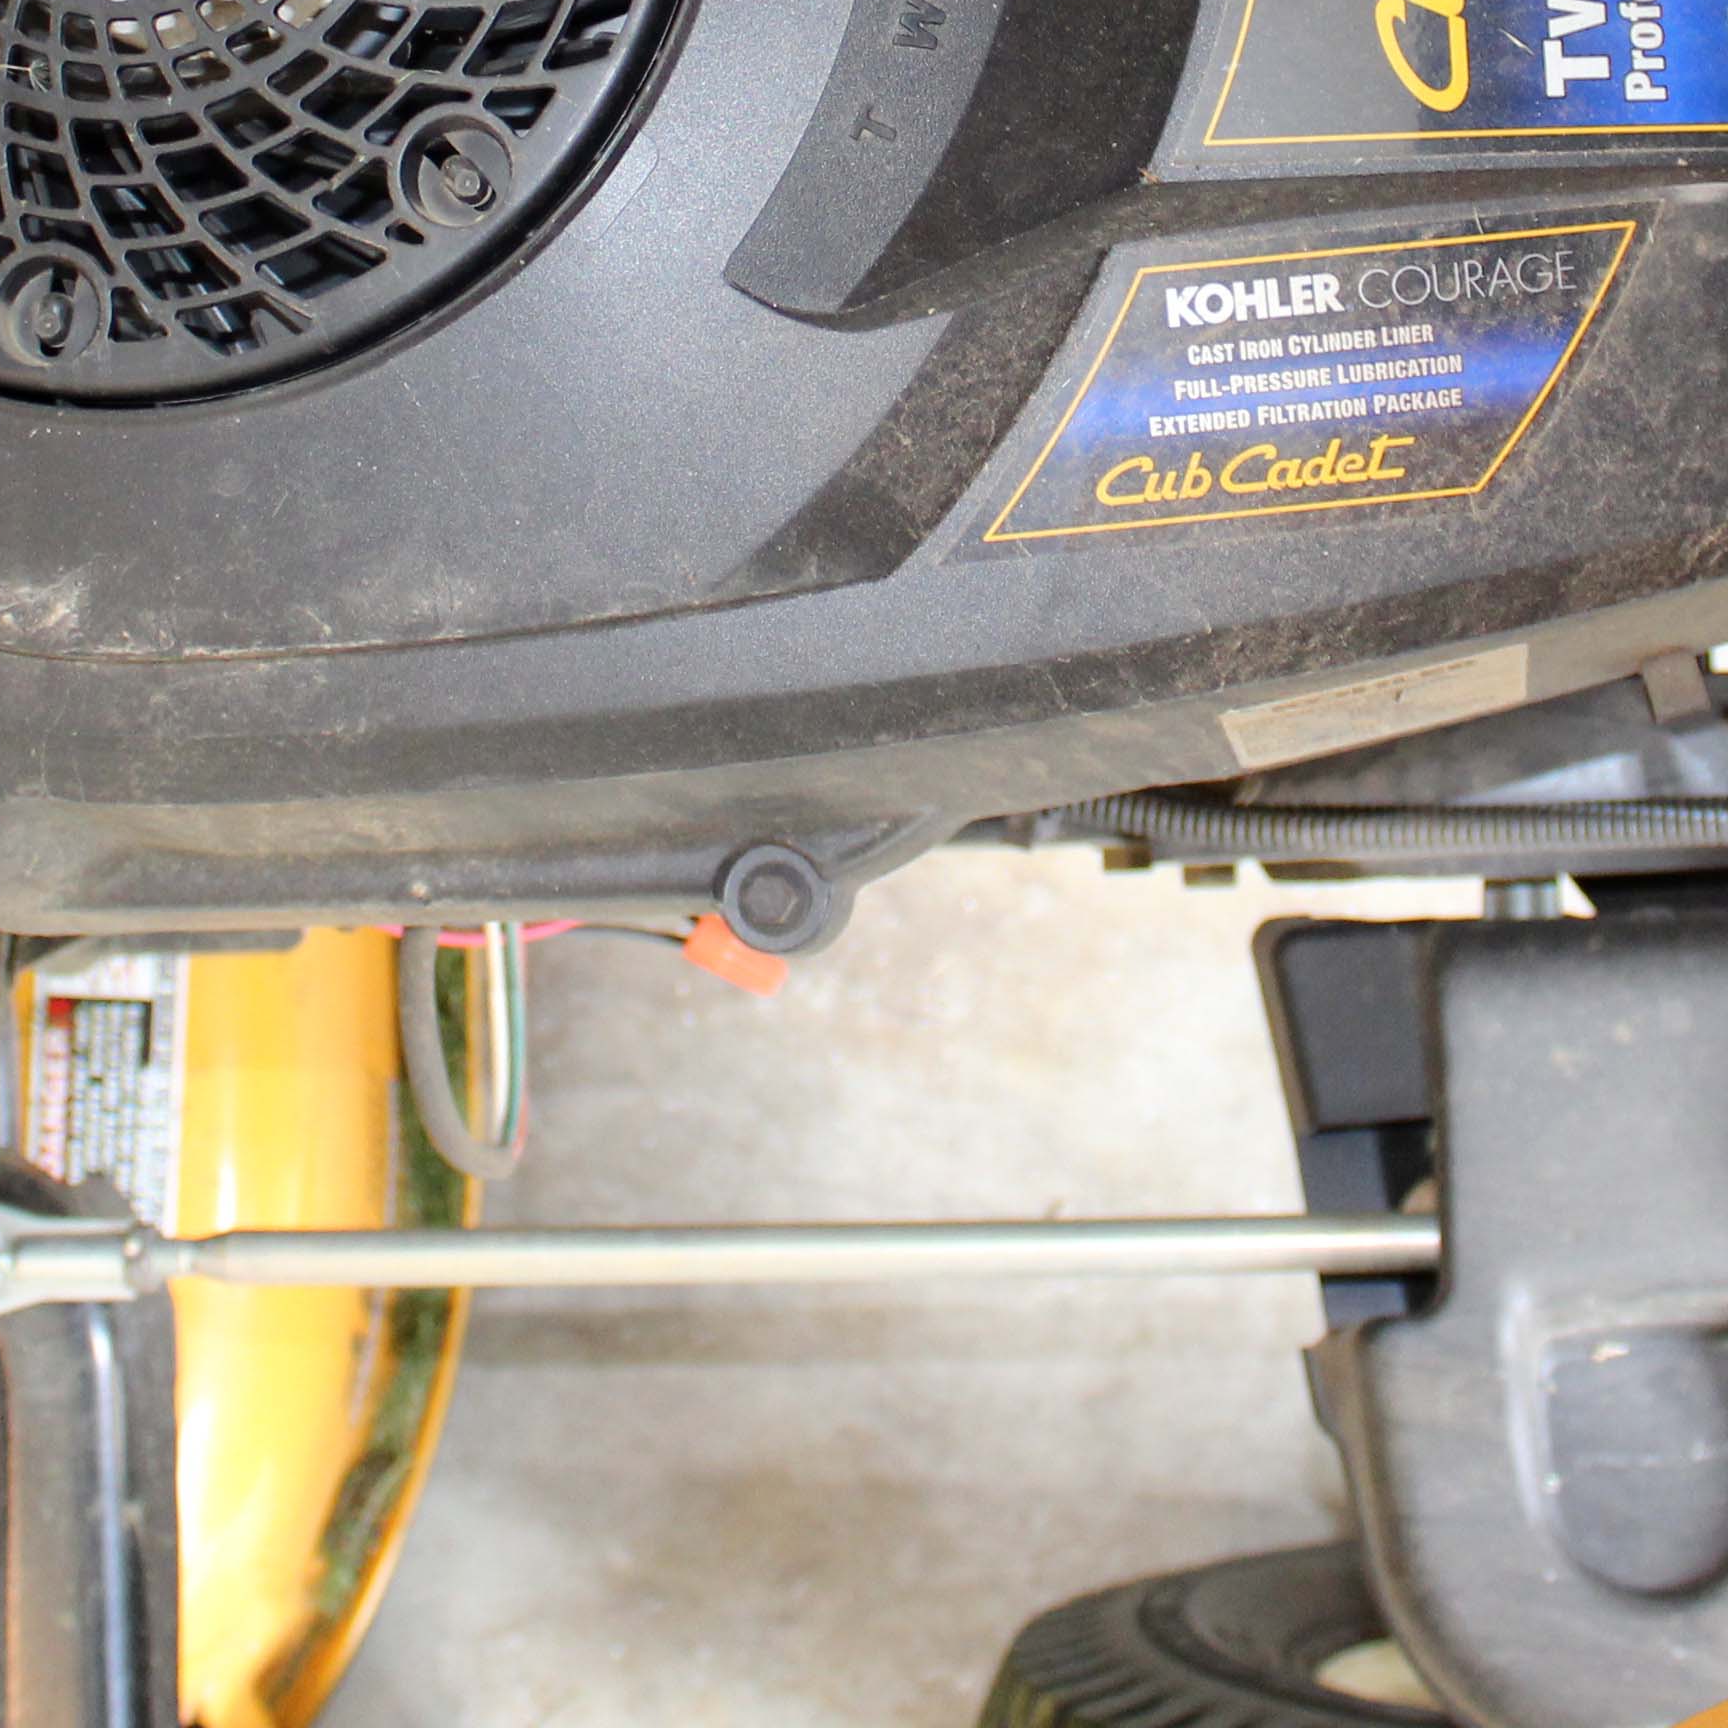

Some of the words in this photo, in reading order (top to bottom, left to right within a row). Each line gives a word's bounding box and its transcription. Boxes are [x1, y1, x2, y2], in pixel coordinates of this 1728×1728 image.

[1166, 272, 1344, 329] KOHLER
[1358, 250, 1577, 309] COURAGE
[1187, 340, 1235, 366] CAST
[1239, 337, 1283, 362] IRON
[1288, 329, 1378, 358] CYLINDER
[1382, 324, 1434, 347] LINER
[1174, 367, 1332, 401] FULL-PRESSURE
[1337, 354, 1463, 385] LUBRICATION
[1149, 407, 1251, 437] EXTENDED
[1257, 397, 1368, 425] FILTRATION
[1373, 386, 1463, 412] PACKAGE
[1095, 456, 1215, 507] Cub
[1220, 434, 1415, 494] Cadet
